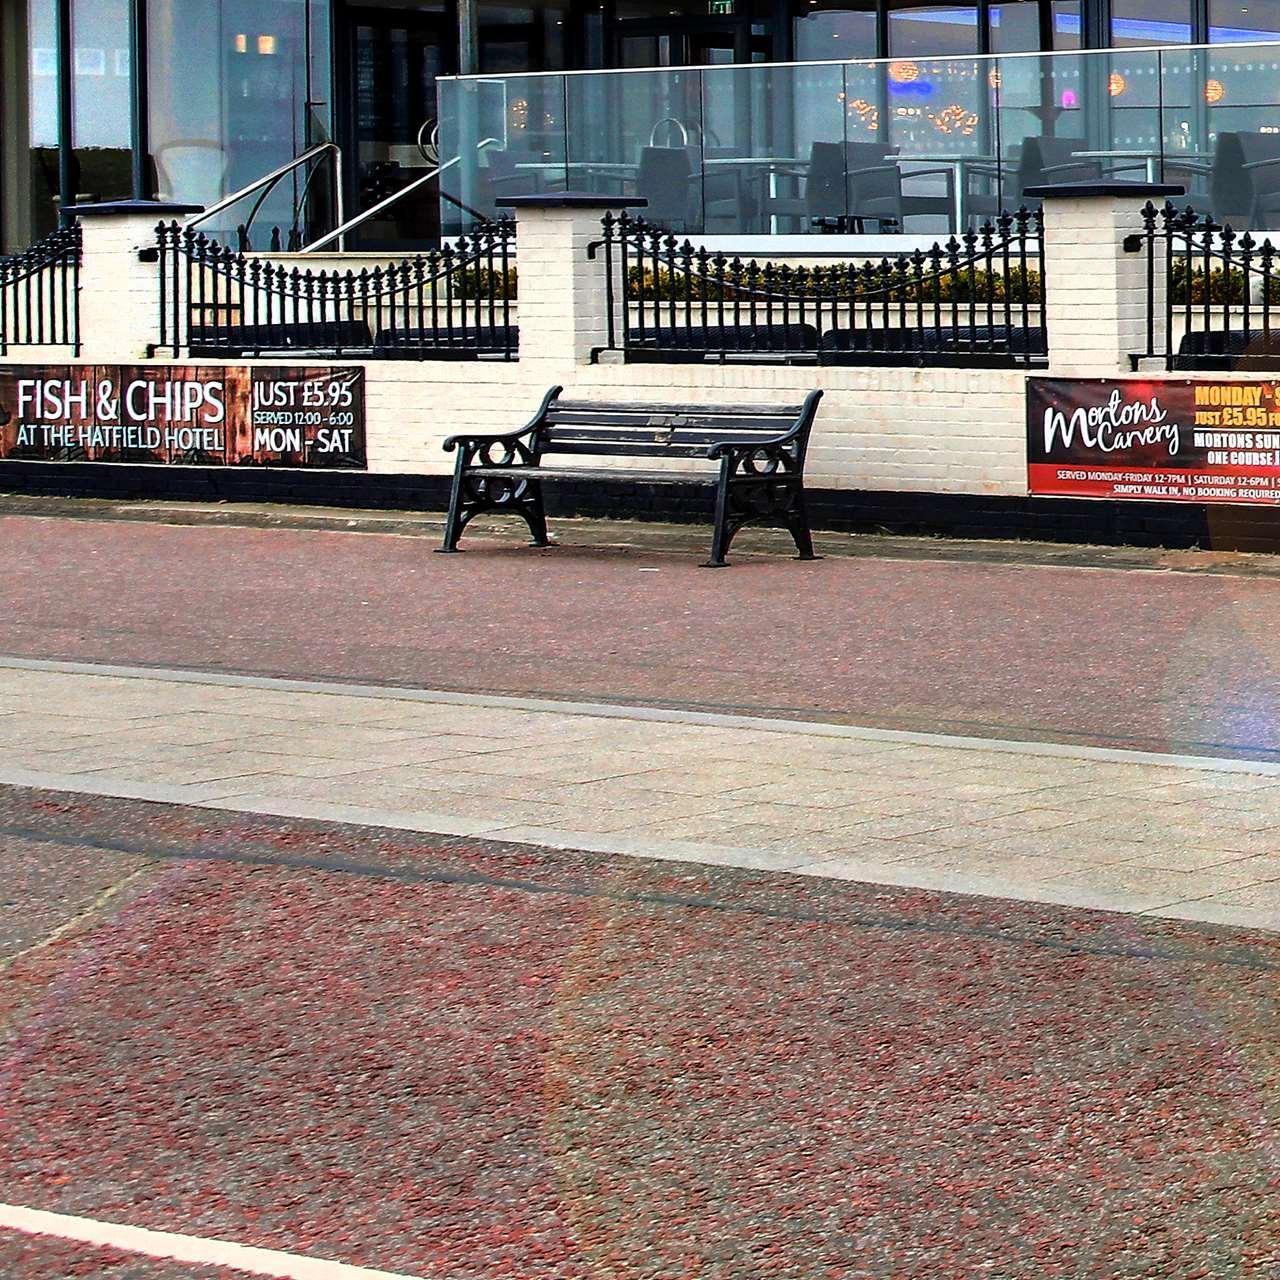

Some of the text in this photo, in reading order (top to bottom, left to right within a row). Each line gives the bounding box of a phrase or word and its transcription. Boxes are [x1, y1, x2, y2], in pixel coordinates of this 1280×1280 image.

[17, 379, 225, 423] FISH & CHIPS
[253, 381, 353, 410] JUST £5.95
[1195, 386, 1263, 406] MONDAY
[253, 411, 293, 425] SERVED
[294, 412, 321, 425] 12:00
[329, 412, 354, 425] 6:00
[1044, 389, 1167, 454] Mortons
[1195, 411, 1221, 425] JUST
[1222, 407, 1267, 426] £5.95
[16, 424, 225, 451] AT THE HATFIELD HOTEL
[253, 428, 299, 452] MON
[317, 429, 353, 453] SAT
[1097, 421, 1180, 455] Carvery
[1193, 432, 1253, 448] MORTONS
[1207, 451, 1228, 465] ONE
[1230, 451, 1273, 466] COURSE
[1056, 470, 1087, 481] SERVED
[1087, 471, 1152, 483] MONDAY-FRIDAY
[1154, 474, 1186, 484] 12-7PM
[1193, 475, 1236, 486] SATURDAY
[1237, 476, 1269, 487] 12-6PM
[1113, 484, 1143, 494] SIMPLY
[1143, 485, 1168, 495] WALK
[1169, 486, 1181, 497] IN,
[1183, 487, 1196, 496] NO
[1197, 487, 1237, 498] BOOKING
